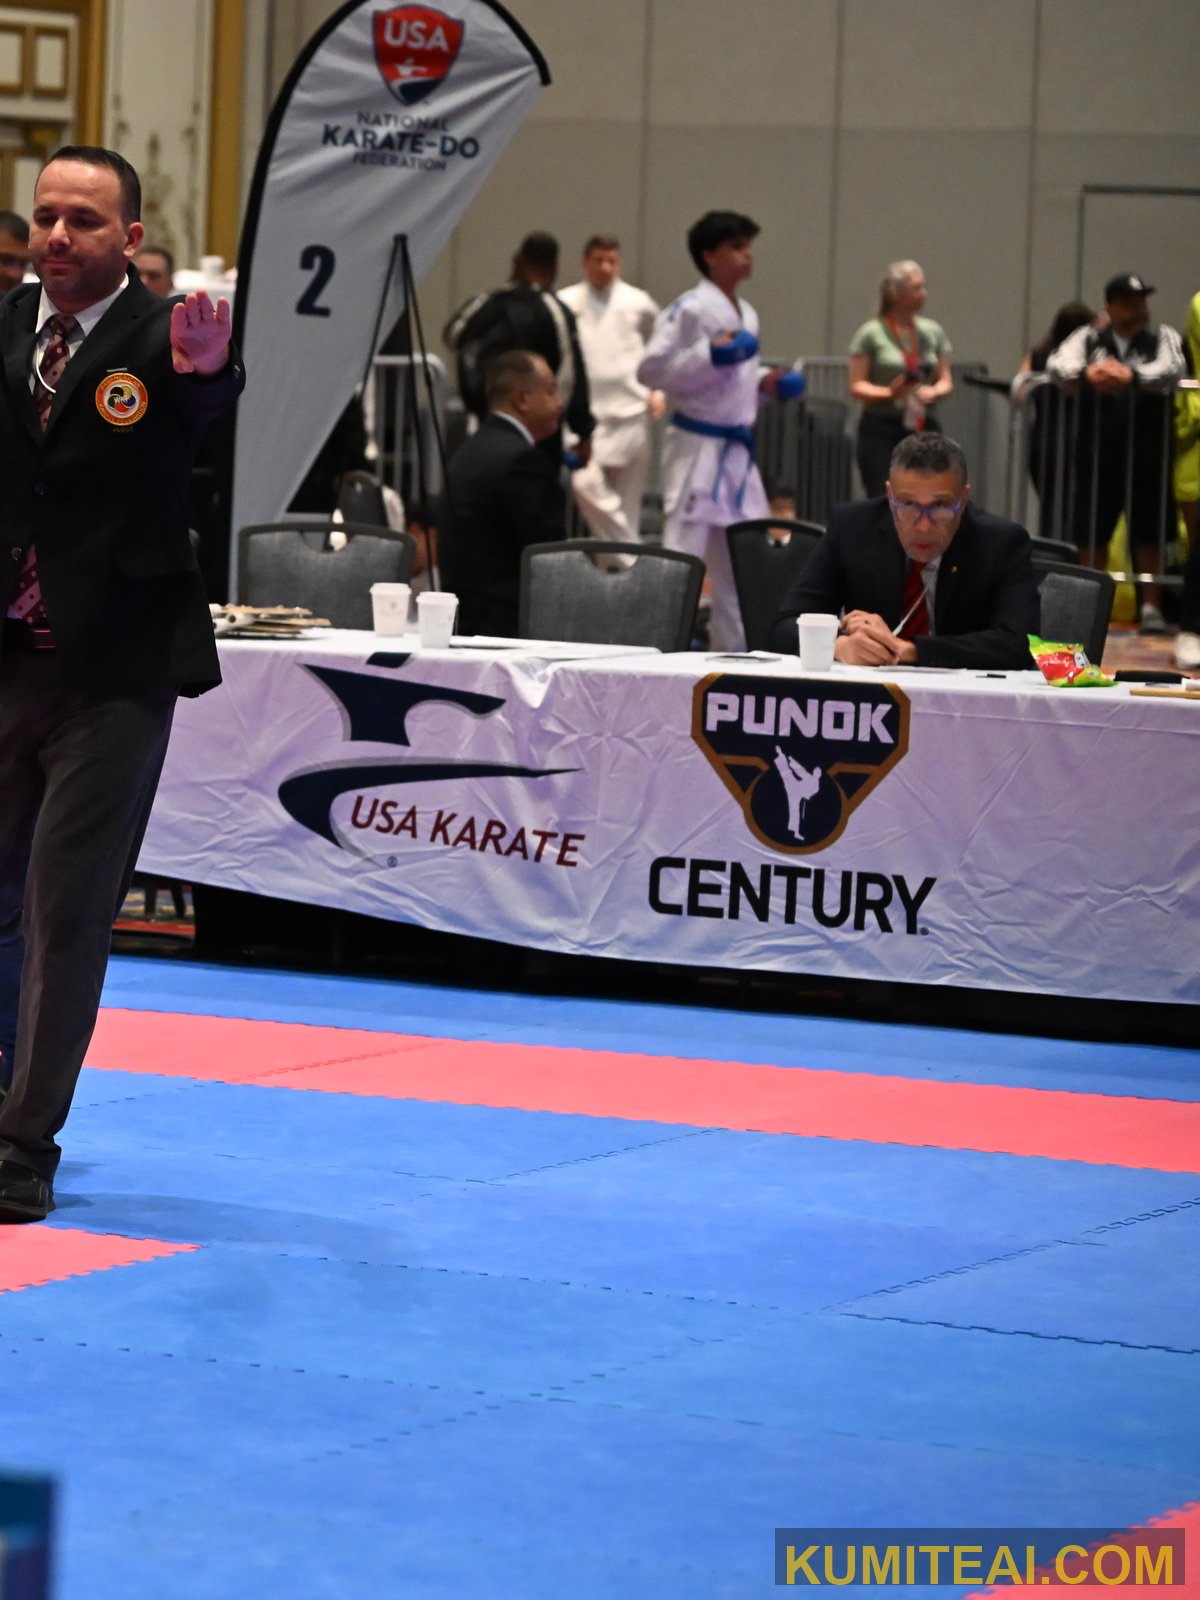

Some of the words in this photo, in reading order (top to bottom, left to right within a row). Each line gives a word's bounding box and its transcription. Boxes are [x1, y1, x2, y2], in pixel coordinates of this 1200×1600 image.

[384, 18, 450, 52] USA
[322, 124, 480, 159] KARATE-DO
[356, 111, 448, 131] NATIONAL
[353, 151, 448, 172] FEDERATION
[295, 244, 336, 317] 2
[706, 692, 895, 744] PUNOK
[351, 795, 418, 839] USA
[430, 809, 586, 867] KARATE
[648, 856, 937, 935] CENTURY
